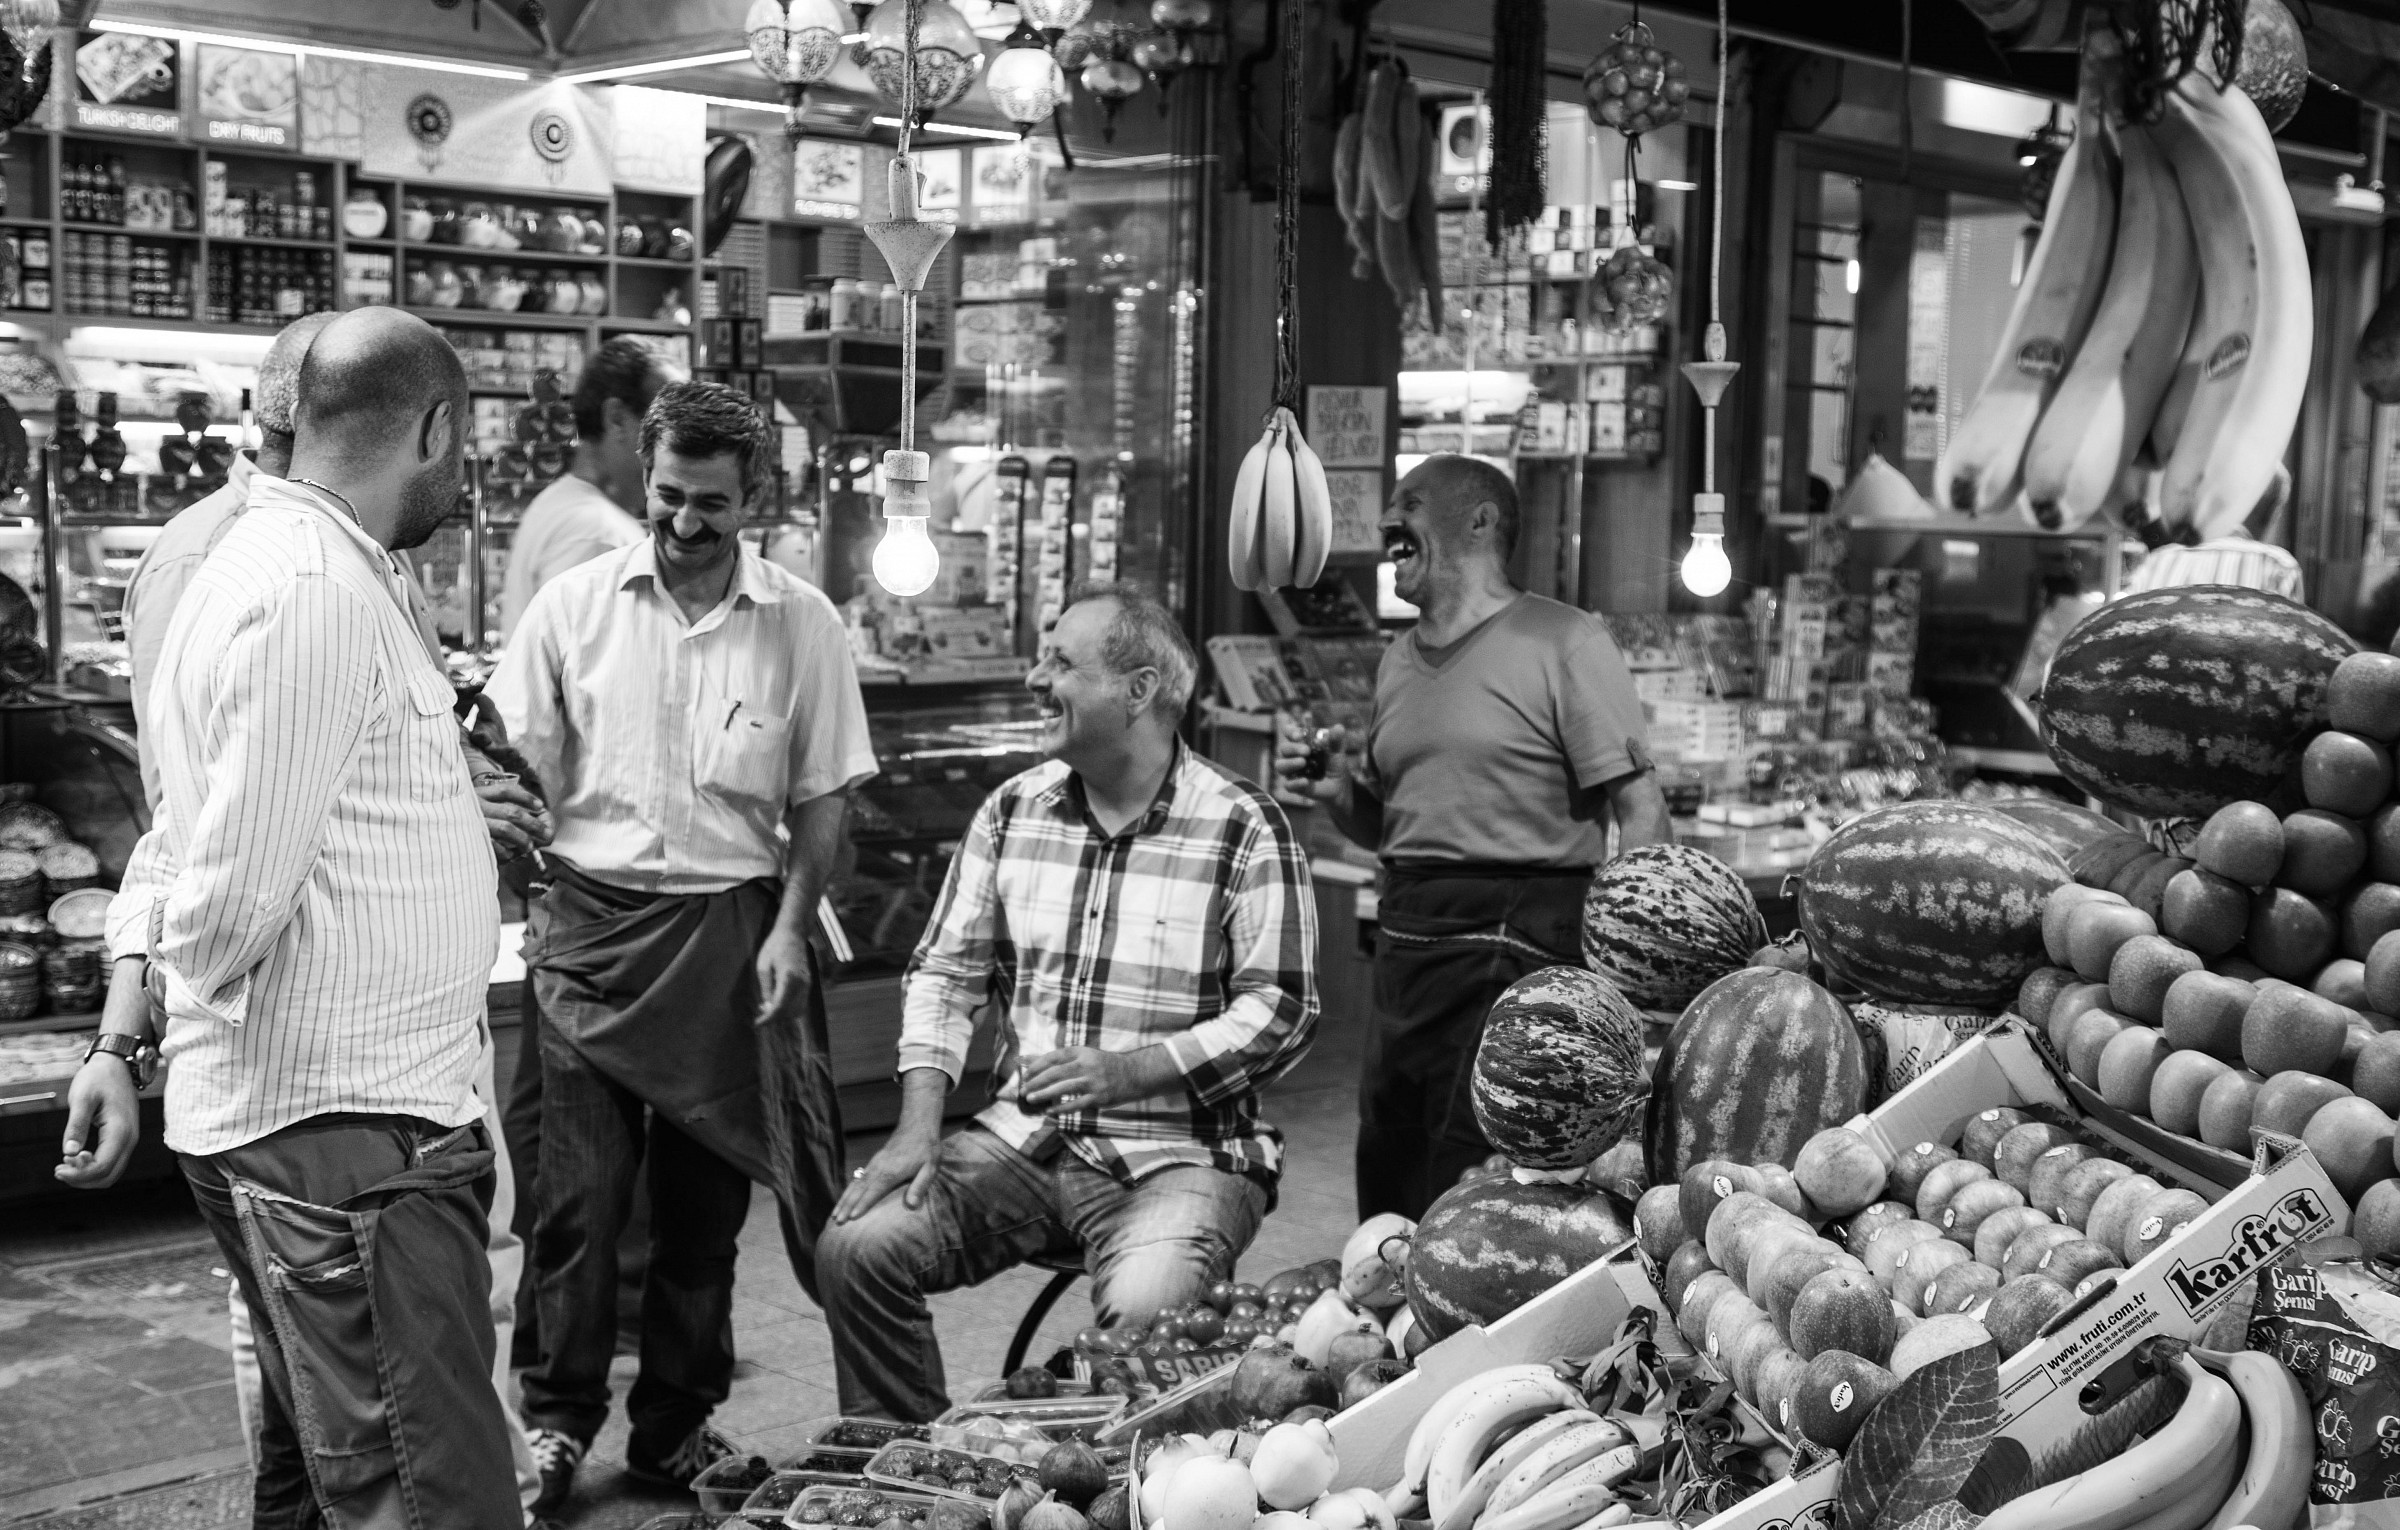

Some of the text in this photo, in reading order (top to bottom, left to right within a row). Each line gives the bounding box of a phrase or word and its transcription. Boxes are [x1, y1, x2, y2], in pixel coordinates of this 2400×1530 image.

[77, 106, 179, 132] TURKISH DELIGHT
[208, 120, 285, 145] DRY FRUITS
[2314, 1459, 2357, 1494] arip
